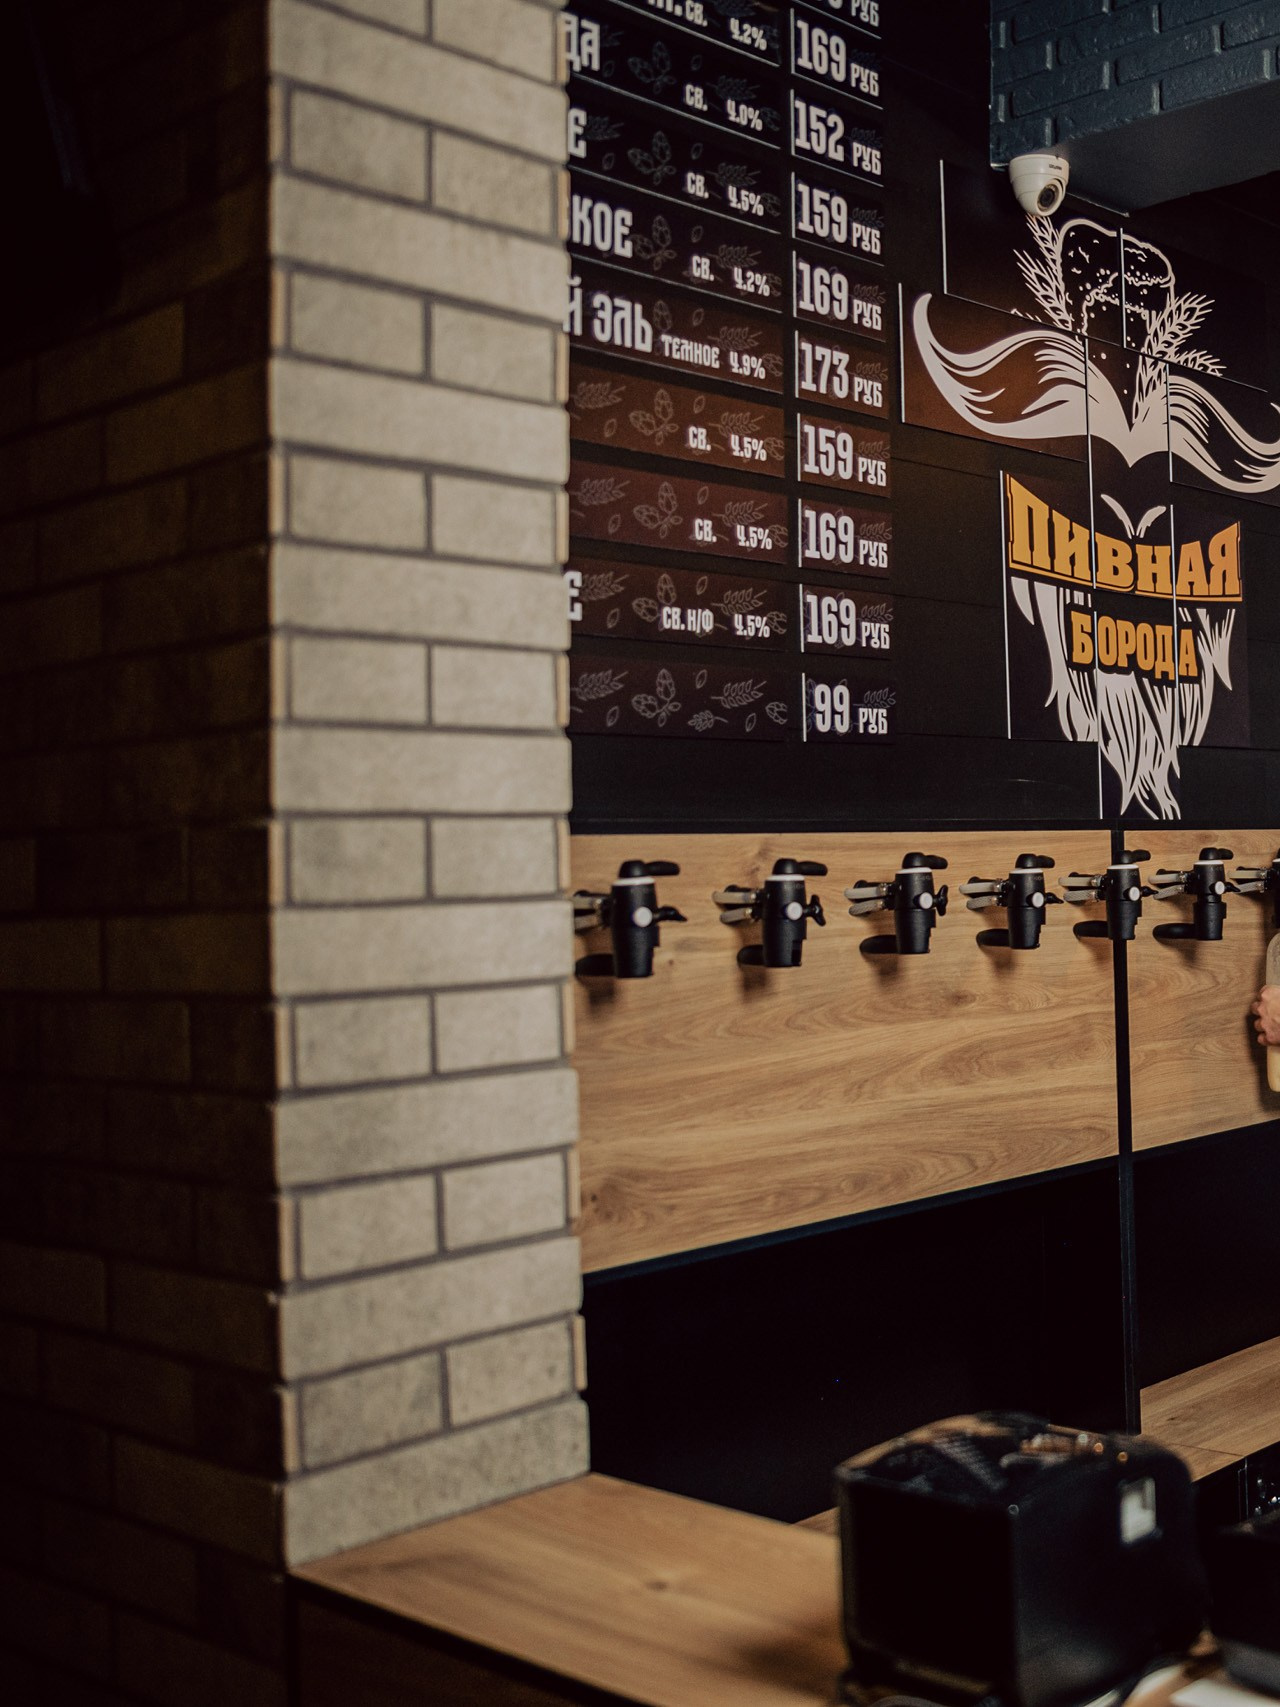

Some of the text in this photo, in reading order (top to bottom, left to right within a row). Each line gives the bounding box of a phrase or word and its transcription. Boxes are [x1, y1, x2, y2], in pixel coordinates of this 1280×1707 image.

[796, 19, 879, 97] 169 РУБ
[685, 84, 708, 112] СВ.
[726, 99, 763, 132] 4.0%
[795, 99, 881, 176] 152 РУБ
[686, 171, 709, 199] СВ.
[728, 185, 764, 217] 4.5%
[797, 183, 881, 256] 159 РУБ
[692, 255, 715, 282] СВ.
[733, 266, 771, 297] 4.2%
[799, 262, 882, 331] 169 РУБ
[592, 292, 653, 354] ЭЛЬ
[661, 334, 720, 371] ТЕМНОЕ
[729, 350, 766, 381] 4.9%
[801, 342, 882, 408] 173 РУБ
[688, 425, 767, 462] СВ. 4.5%
[803, 424, 887, 487] 159 РУБ
[694, 518, 773, 550] СВ. 4.5%
[804, 509, 888, 568] 169 РУБ
[1008, 474, 1242, 600] ПИВНАЯ
[734, 613, 770, 638] 4.5%
[806, 595, 890, 649] 169 РУБ
[1071, 609, 1198, 680] БОРОДА
[814, 684, 888, 735] 99 РУБ
